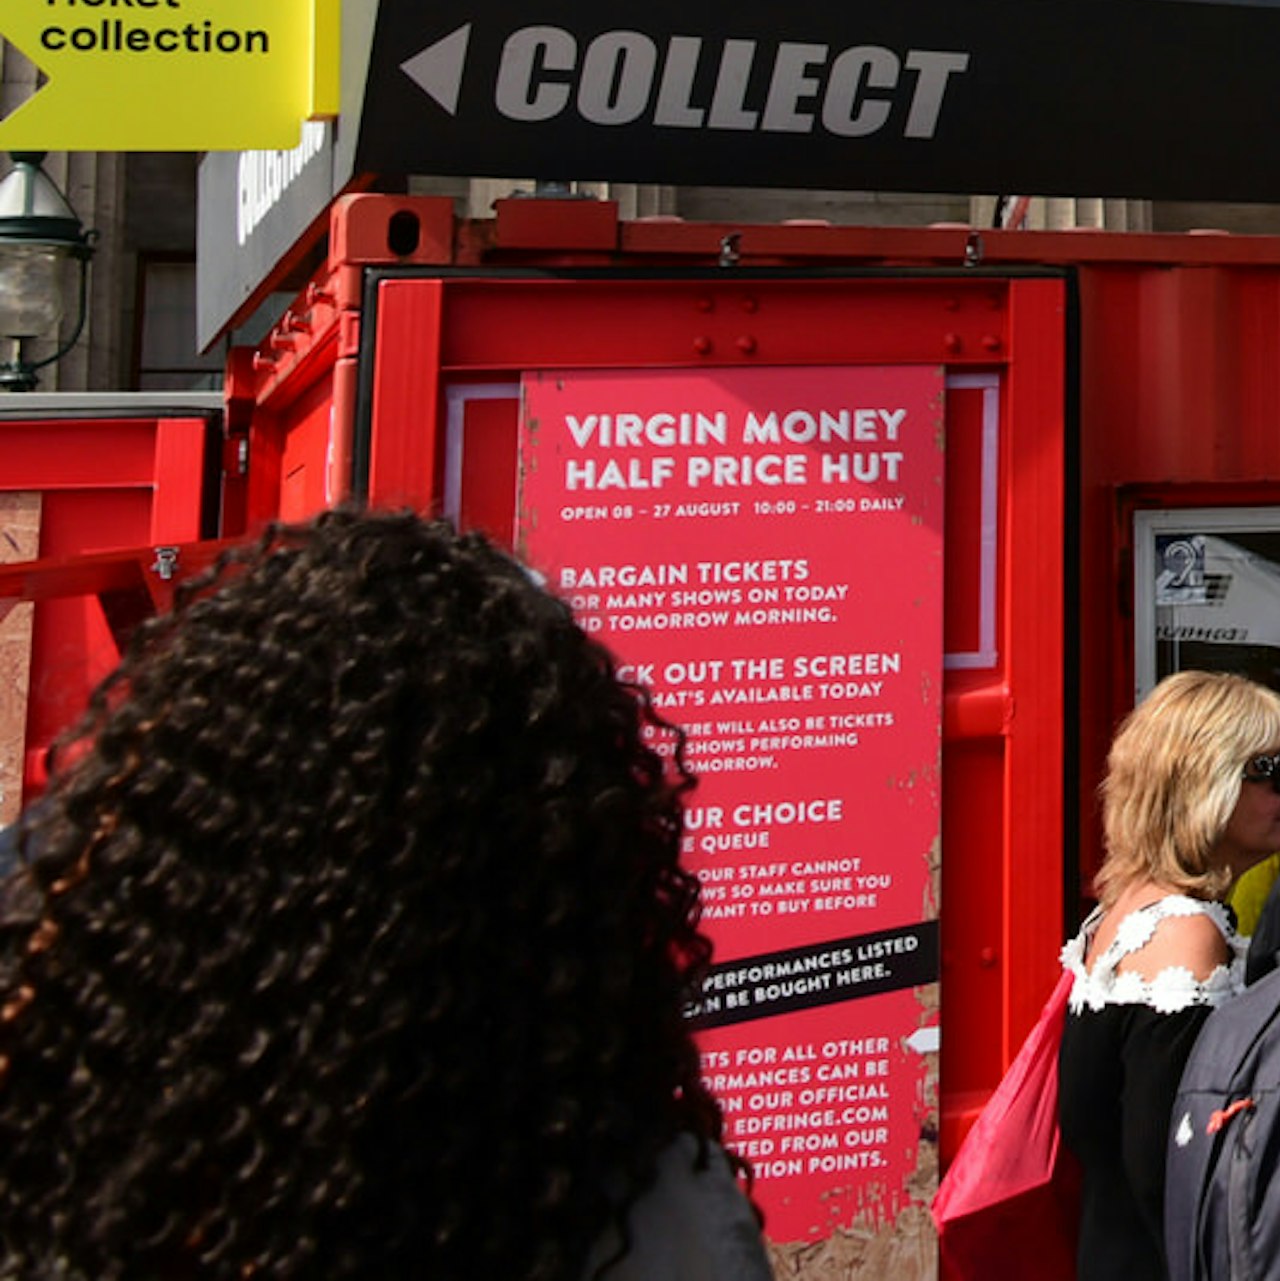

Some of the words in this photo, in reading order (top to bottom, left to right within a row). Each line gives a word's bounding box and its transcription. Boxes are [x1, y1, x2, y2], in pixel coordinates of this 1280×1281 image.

[41, 19, 268, 52] collection
[496, 26, 969, 137] COLLECT
[566, 412, 726, 448] VIRGIN
[743, 409, 905, 444] MONEY
[566, 458, 674, 490] HALF
[688, 455, 806, 487] PRICE
[822, 452, 903, 483] HUT
[561, 507, 607, 520] OPEN
[654, 505, 670, 517] 27
[675, 502, 740, 516] AUGUST
[754, 501, 795, 514] 10:00
[816, 499, 855, 512] 21:00
[860, 498, 903, 511] DAILY
[561, 564, 687, 587] BARGAIN
[697, 560, 808, 583] TICKETS
[606, 592, 664, 609] MANY
[671, 590, 741, 606] SHOWS
[748, 588, 777, 603] ON
[785, 586, 848, 601] TODAY
[609, 612, 728, 630] TOMORROW
[734, 607, 836, 624] MORNING.
[664, 661, 723, 684] OUT
[731, 659, 784, 680] THE
[794, 653, 899, 677] SCREEN
[710, 685, 813, 704] AVAILABLE
[819, 682, 882, 698] TODAY
[733, 800, 842, 826] CHOICE
[701, 832, 768, 854] QUEUE
[858, 936, 918, 960] LISTED
[726, 990, 749, 1008] BE
[755, 974, 831, 1002] BOUGHT
[837, 963, 891, 985] HERE.
[822, 1038, 889, 1058] OTHER
[735, 1106, 887, 1135] EDFRINGE.COM
